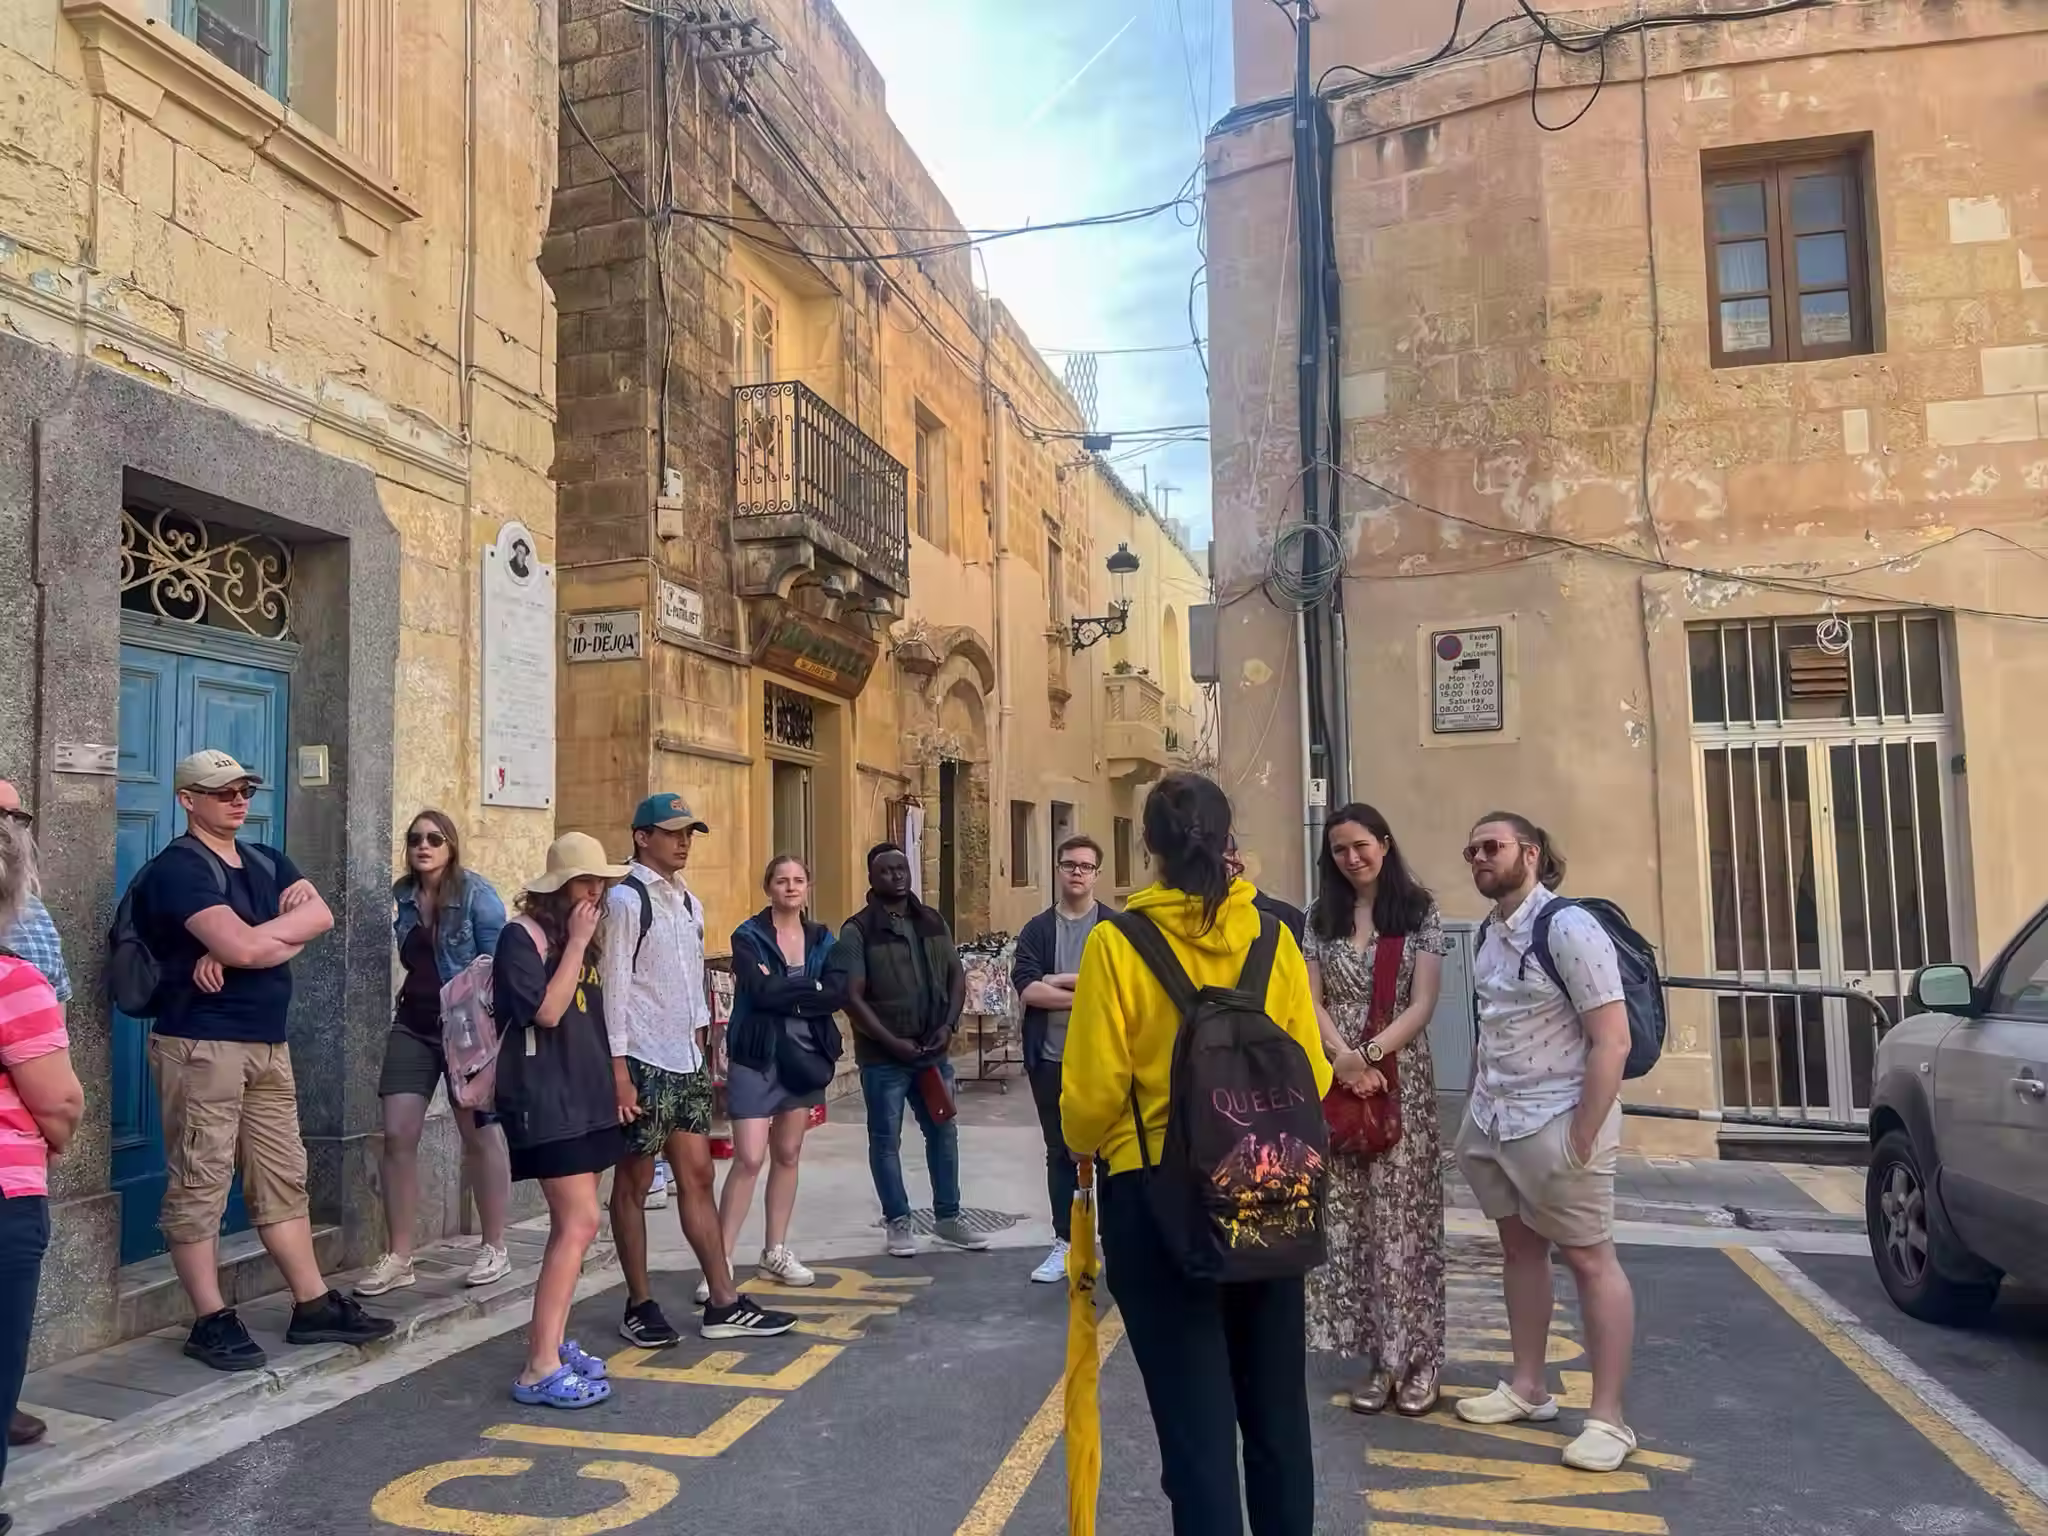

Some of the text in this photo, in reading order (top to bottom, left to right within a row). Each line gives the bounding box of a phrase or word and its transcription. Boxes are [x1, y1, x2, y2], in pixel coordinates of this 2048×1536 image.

[594, 621, 613, 633] TRIQ
[1469, 632, 1493, 641] Except
[573, 634, 635, 654] ID-DEJQA
[1475, 641, 1488, 649] For
[1449, 674, 1466, 682] Mon
[1474, 673, 1485, 681] Fri
[1449, 697, 1485, 705] Saturday
[1212, 1087, 1305, 1127] QUEEN
